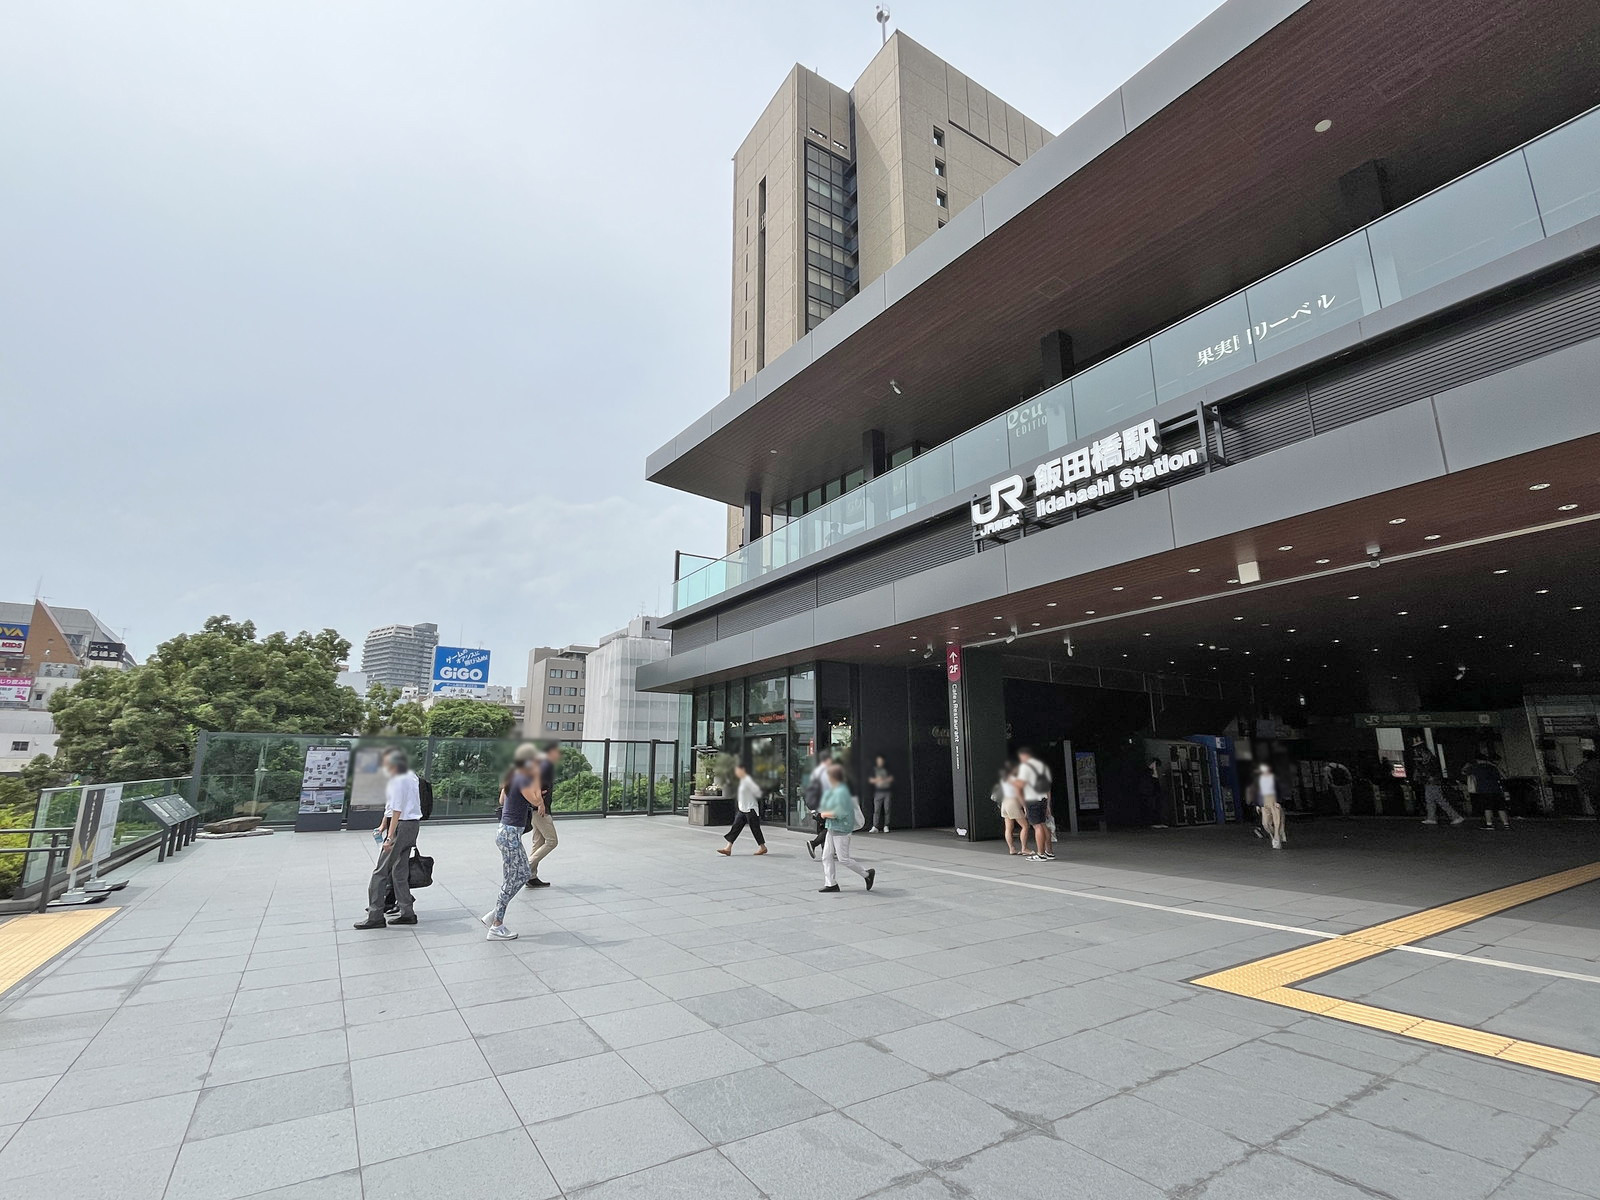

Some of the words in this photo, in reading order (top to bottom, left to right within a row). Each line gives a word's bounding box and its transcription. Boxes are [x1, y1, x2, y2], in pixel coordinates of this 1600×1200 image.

[1034, 418, 1158, 496] 飯田橋駅
[1035, 474, 1115, 518] Iidabashi
[1119, 448, 1198, 488] Station
[972, 475, 1026, 524] JR
[0, 626, 24, 637] VA
[2, 641, 23, 649] KIDS
[439, 666, 483, 681] GiGO
[949, 664, 959, 674] 2F
